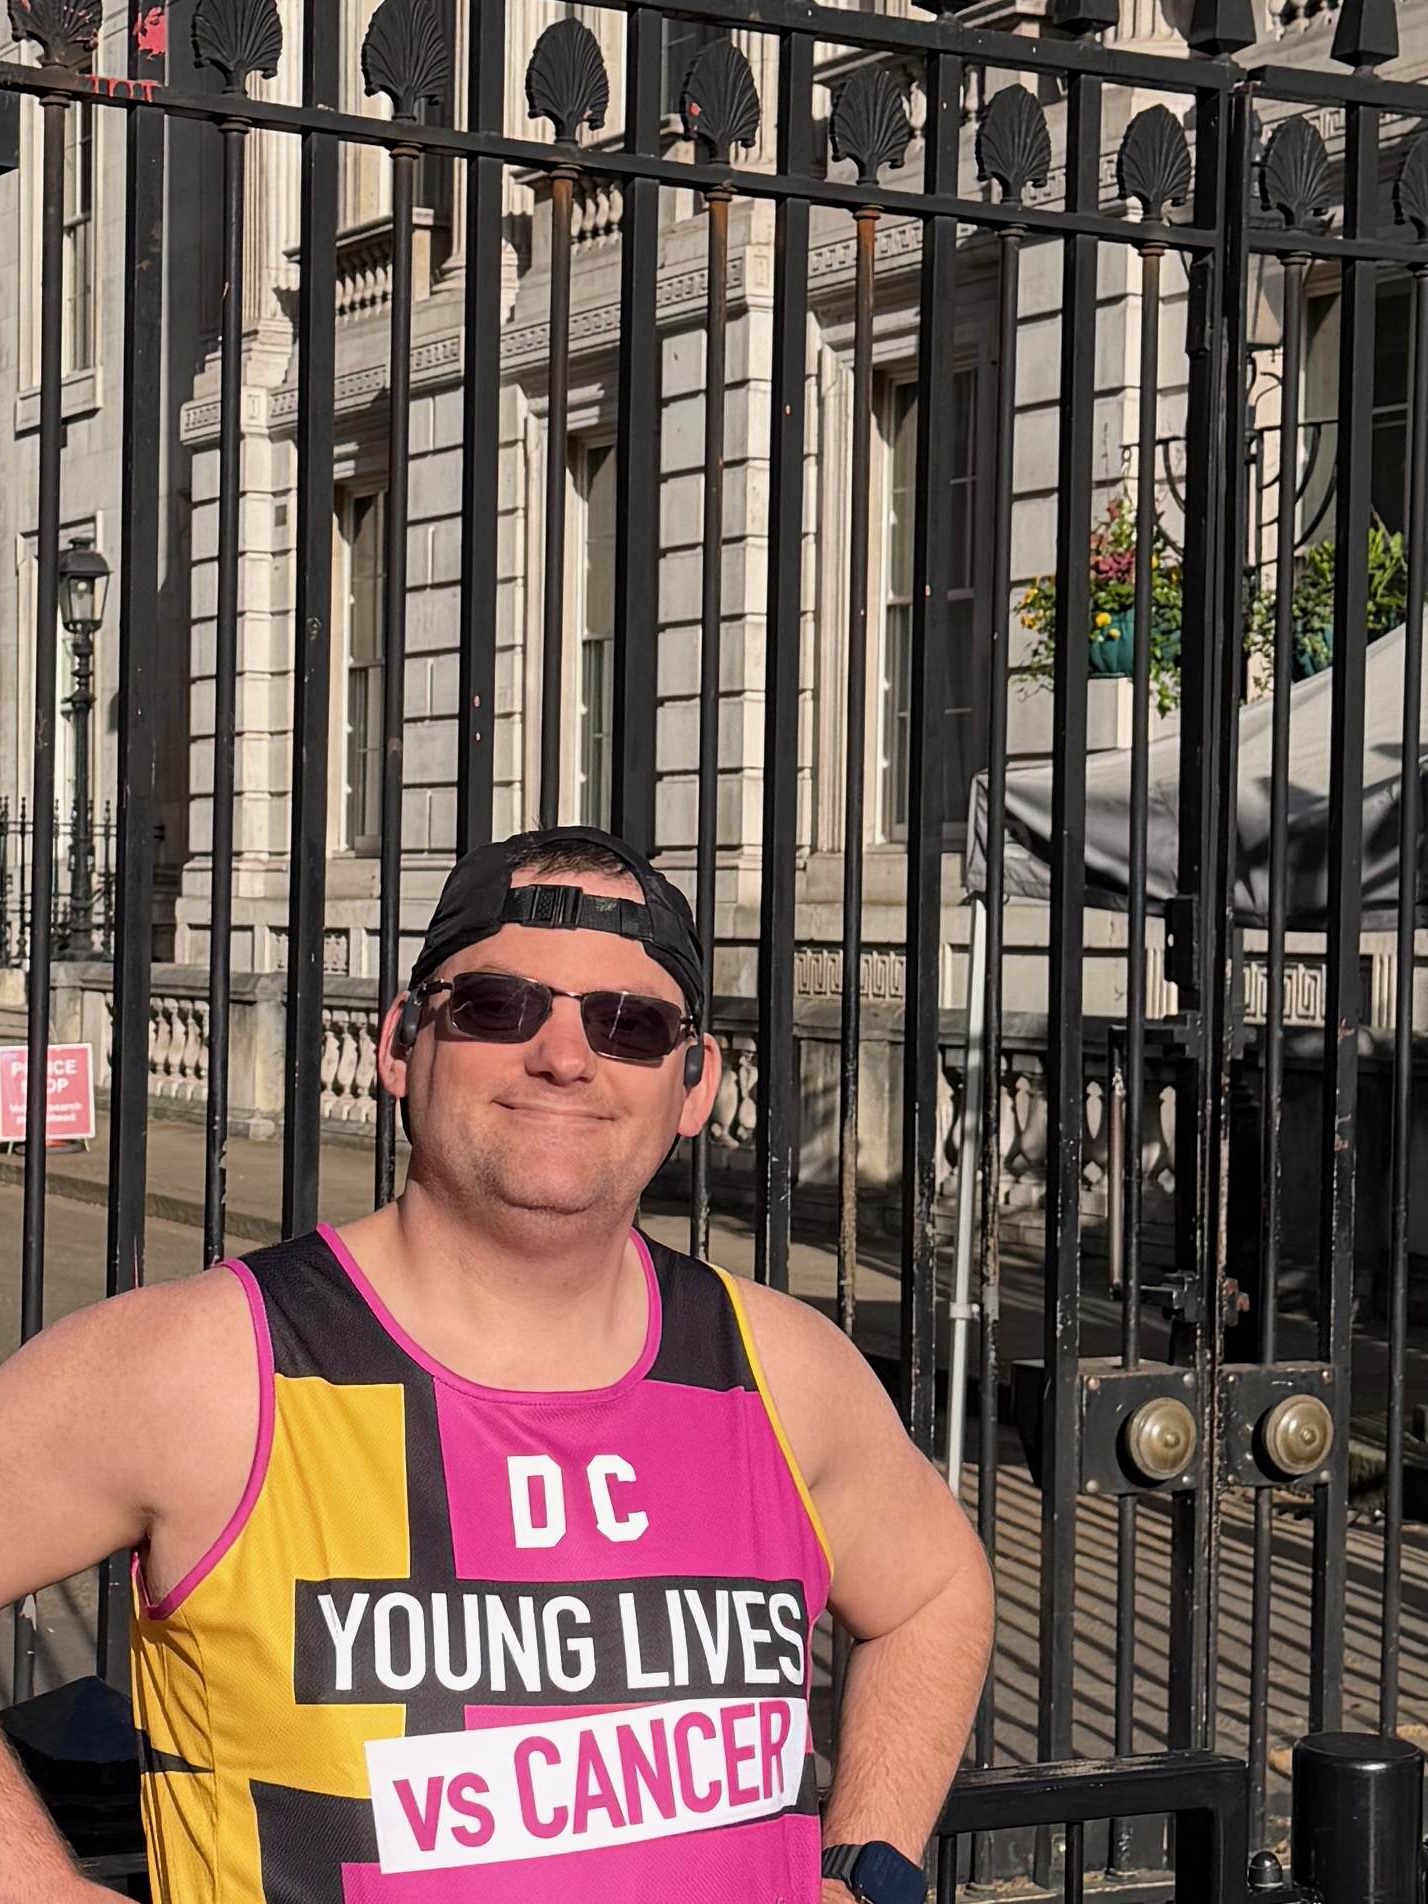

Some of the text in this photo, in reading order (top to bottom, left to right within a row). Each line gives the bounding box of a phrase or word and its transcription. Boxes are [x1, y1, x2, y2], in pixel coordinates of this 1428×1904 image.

[318, 1589, 804, 1692] YOUNG LIVES
[514, 1699, 791, 1839] CANCER
